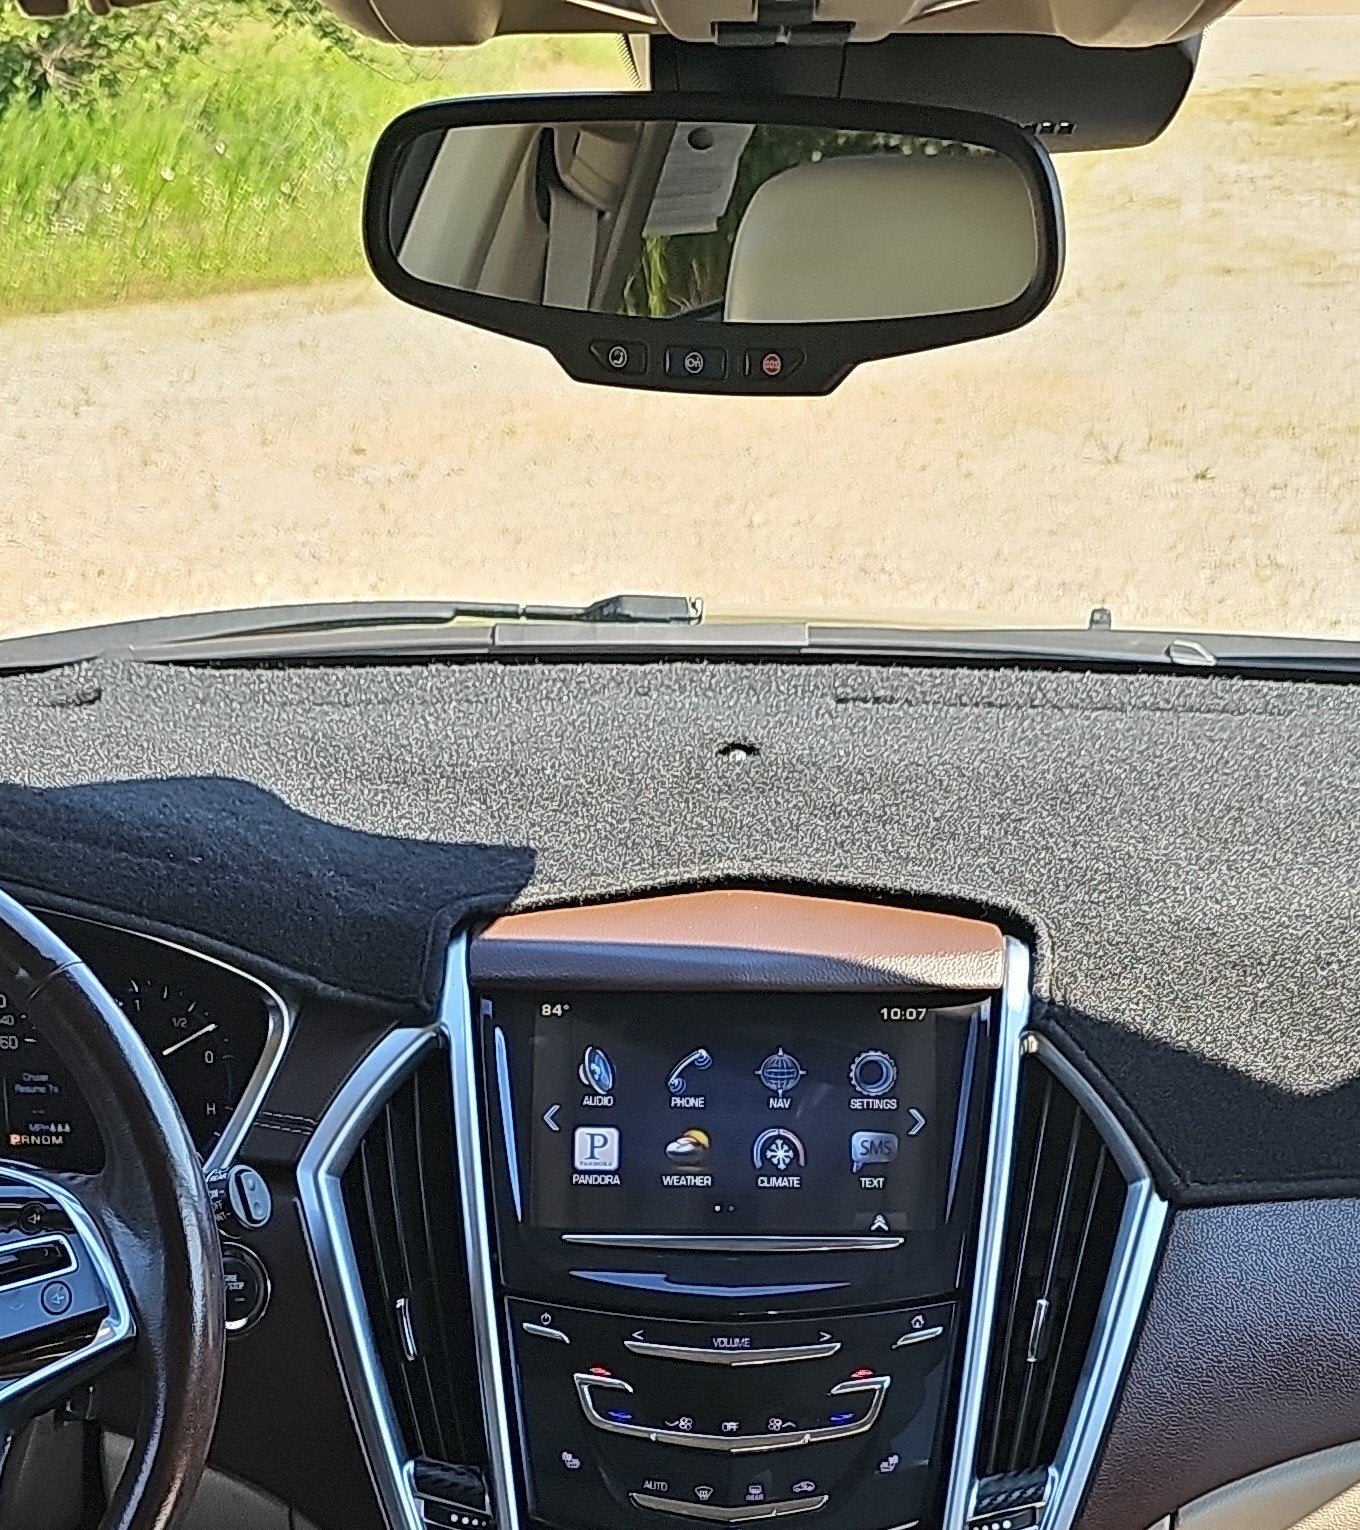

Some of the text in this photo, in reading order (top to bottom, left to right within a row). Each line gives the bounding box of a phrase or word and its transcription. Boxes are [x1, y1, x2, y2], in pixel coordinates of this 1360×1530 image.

[541, 1003, 570, 1016] 84°
[880, 1007, 927, 1020] 10:07
[582, 1096, 614, 1106] AUDIO
[670, 1097, 705, 1108] PHONE
[769, 1098, 791, 1109] NAV
[850, 1099, 897, 1110] SETTINGS
[206, 1102, 216, 1115] H
[585, 1132, 609, 1160] P
[860, 1139, 891, 1156] SMS
[572, 1174, 620, 1185] PANDORA
[662, 1175, 712, 1186] WEATHER
[757, 1176, 801, 1188] CLIMATE
[859, 1177, 885, 1188] TEXT
[712, 1337, 751, 1348] VOLUME
[721, 1422, 739, 1432] OFF
[643, 1480, 668, 1491] AUTO
